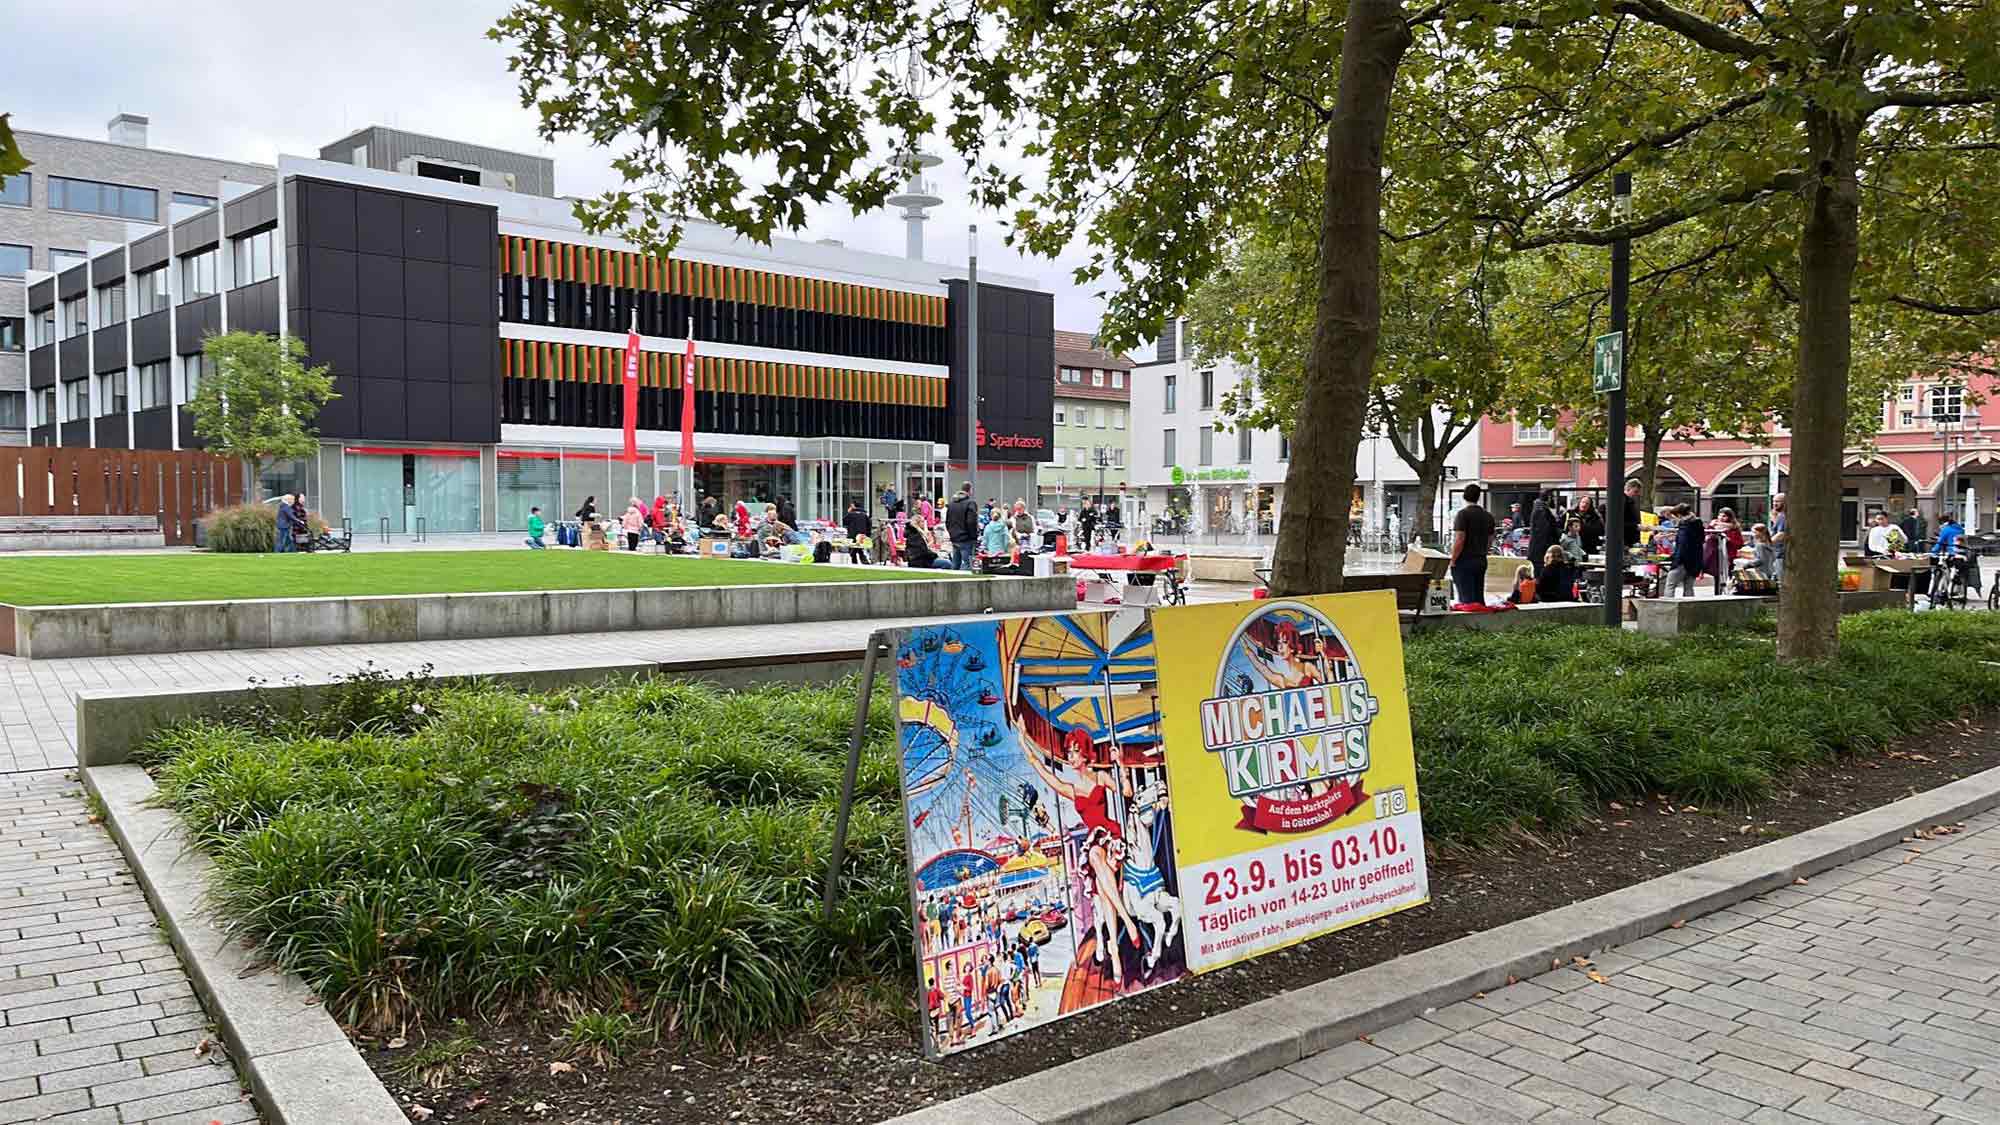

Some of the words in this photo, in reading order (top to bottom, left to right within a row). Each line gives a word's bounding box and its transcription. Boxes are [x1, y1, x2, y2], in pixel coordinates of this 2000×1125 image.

[990, 432, 1045, 450] Sparkasse
[1203, 684, 1377, 746] MICHAELIS-
[1228, 728, 1368, 792] KIRMES
[1268, 804, 1284, 815] Auf
[1284, 806, 1302, 815] dem
[1302, 791, 1342, 813] Marktplatz
[1281, 818, 1291, 829] in
[1292, 809, 1333, 828] Gütersloh!
[1202, 860, 1276, 905] 23.9.
[1283, 849, 1322, 884] bis
[1331, 827, 1406, 870] 03.10.
[1199, 904, 1257, 932] Täglich
[1261, 898, 1287, 915] von
[1291, 883, 1328, 905] 14-23
[1332, 878, 1355, 894] Uhr
[1359, 858, 1415, 890] geöffnet!
[1200, 943, 1214, 956] Mit
[1216, 931, 1260, 951] attraktiven
[1335, 905, 1349, 914] und
